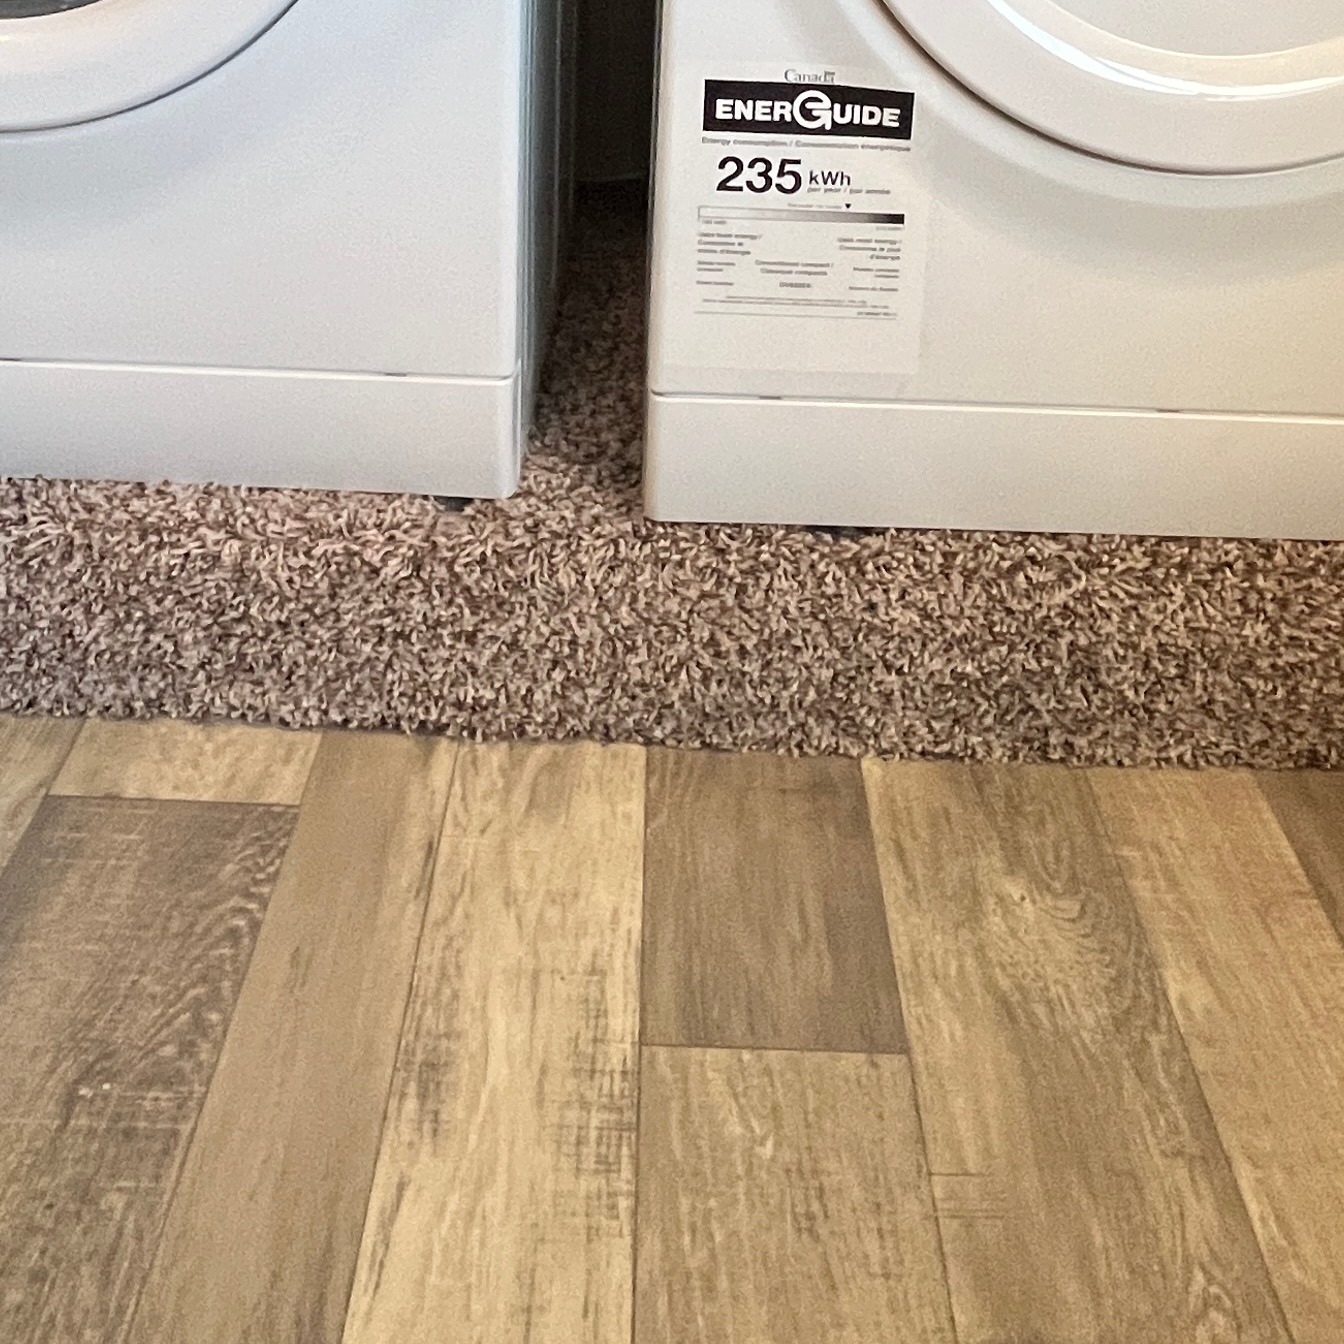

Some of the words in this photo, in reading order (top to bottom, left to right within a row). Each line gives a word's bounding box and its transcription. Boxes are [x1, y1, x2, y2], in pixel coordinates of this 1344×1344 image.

[784, 68, 836, 84] Canada
[715, 90, 901, 130] ENERGUIDE
[716, 156, 802, 194] 235
[809, 170, 851, 187] kWh
